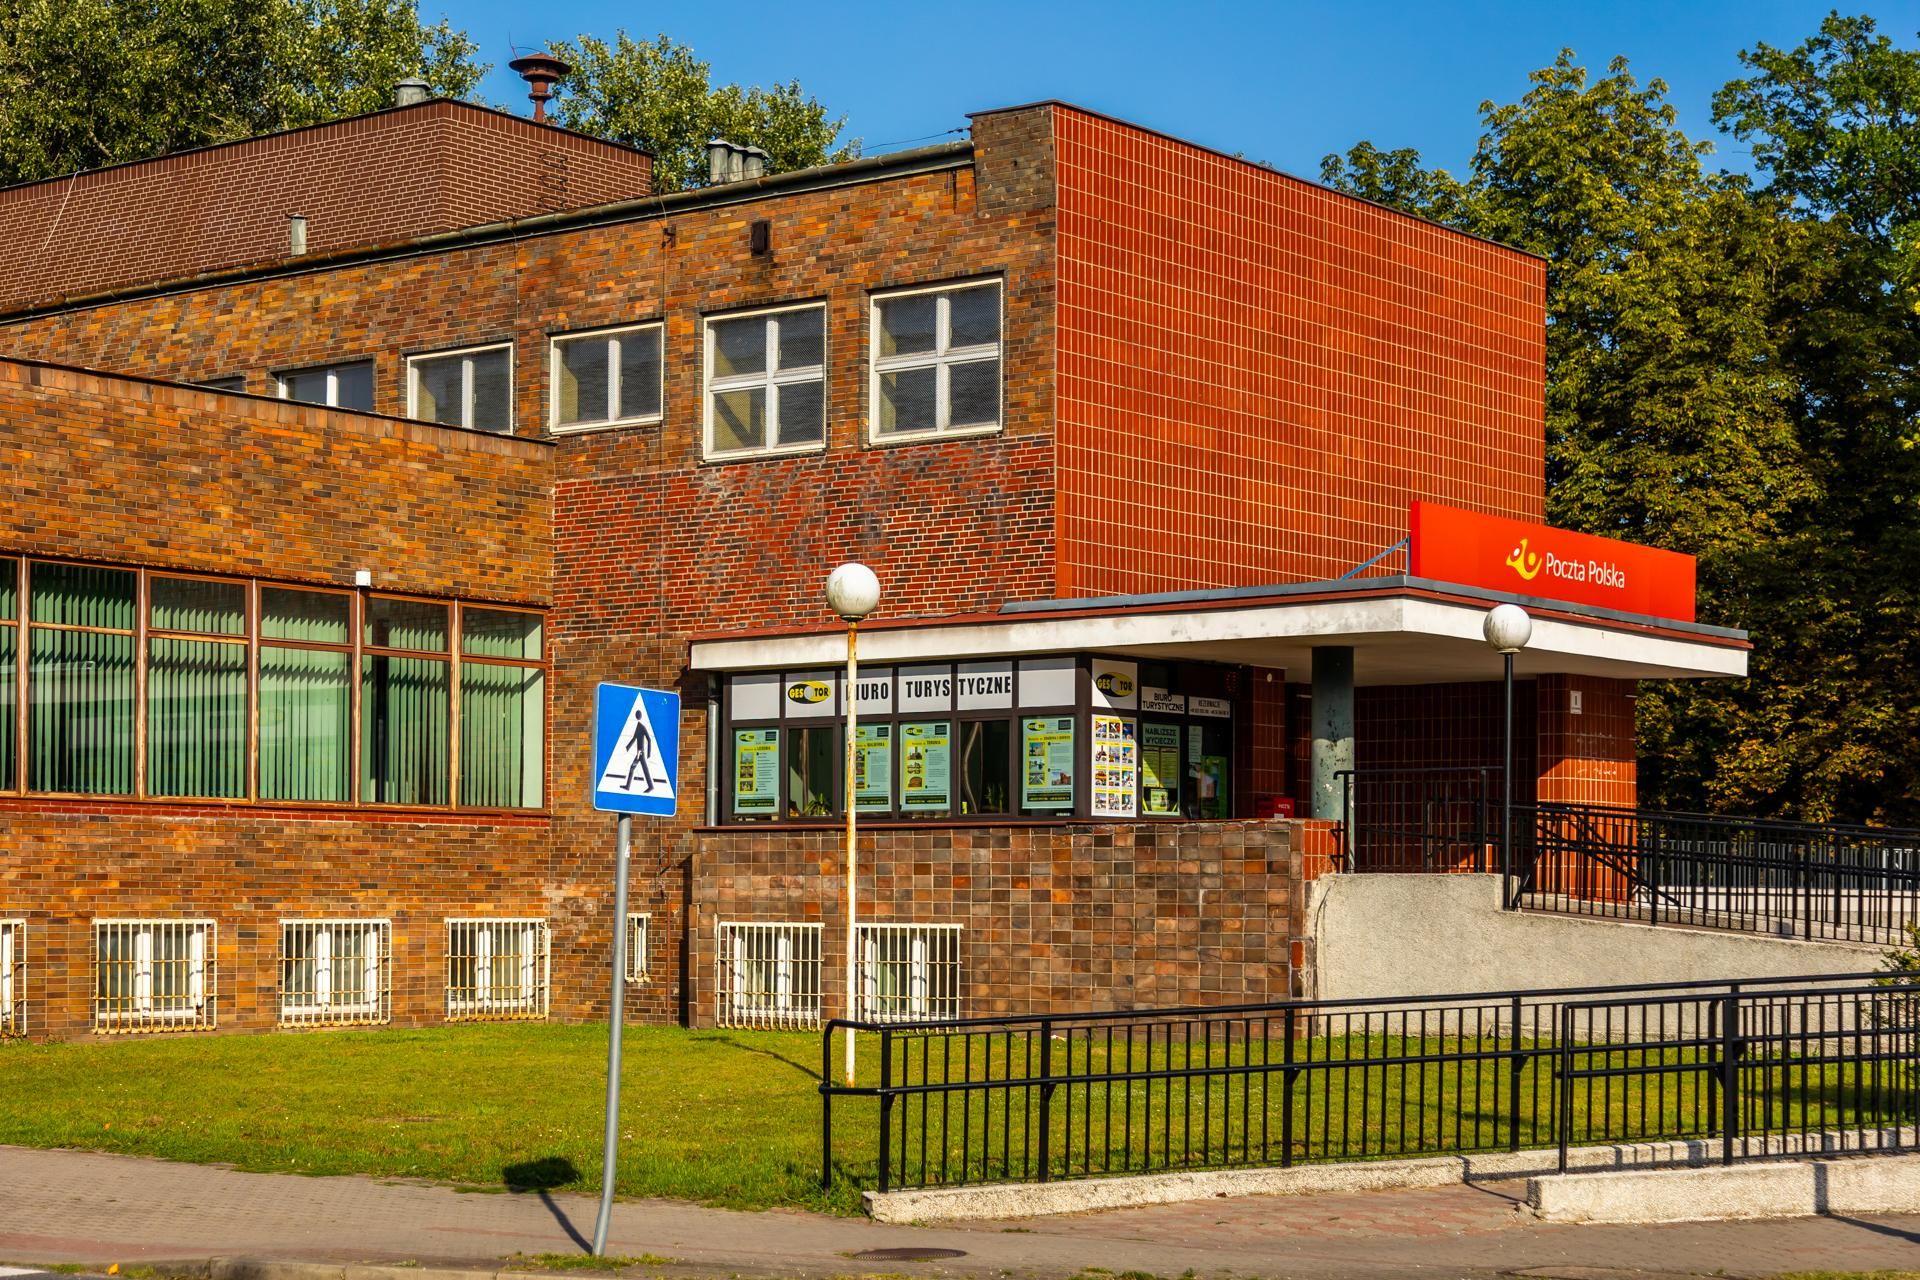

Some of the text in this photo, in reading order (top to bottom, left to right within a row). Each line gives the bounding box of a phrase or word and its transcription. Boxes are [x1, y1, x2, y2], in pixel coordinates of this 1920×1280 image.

[1546, 552, 1625, 589] Poczta Polska
[845, 682, 889, 700] IURO
[1119, 680, 1133, 691] TOR
[789, 687, 829, 699] GES TOR
[1153, 693, 1173, 702] BIURO
[1143, 700, 1184, 712] TURYSTYCZNE
